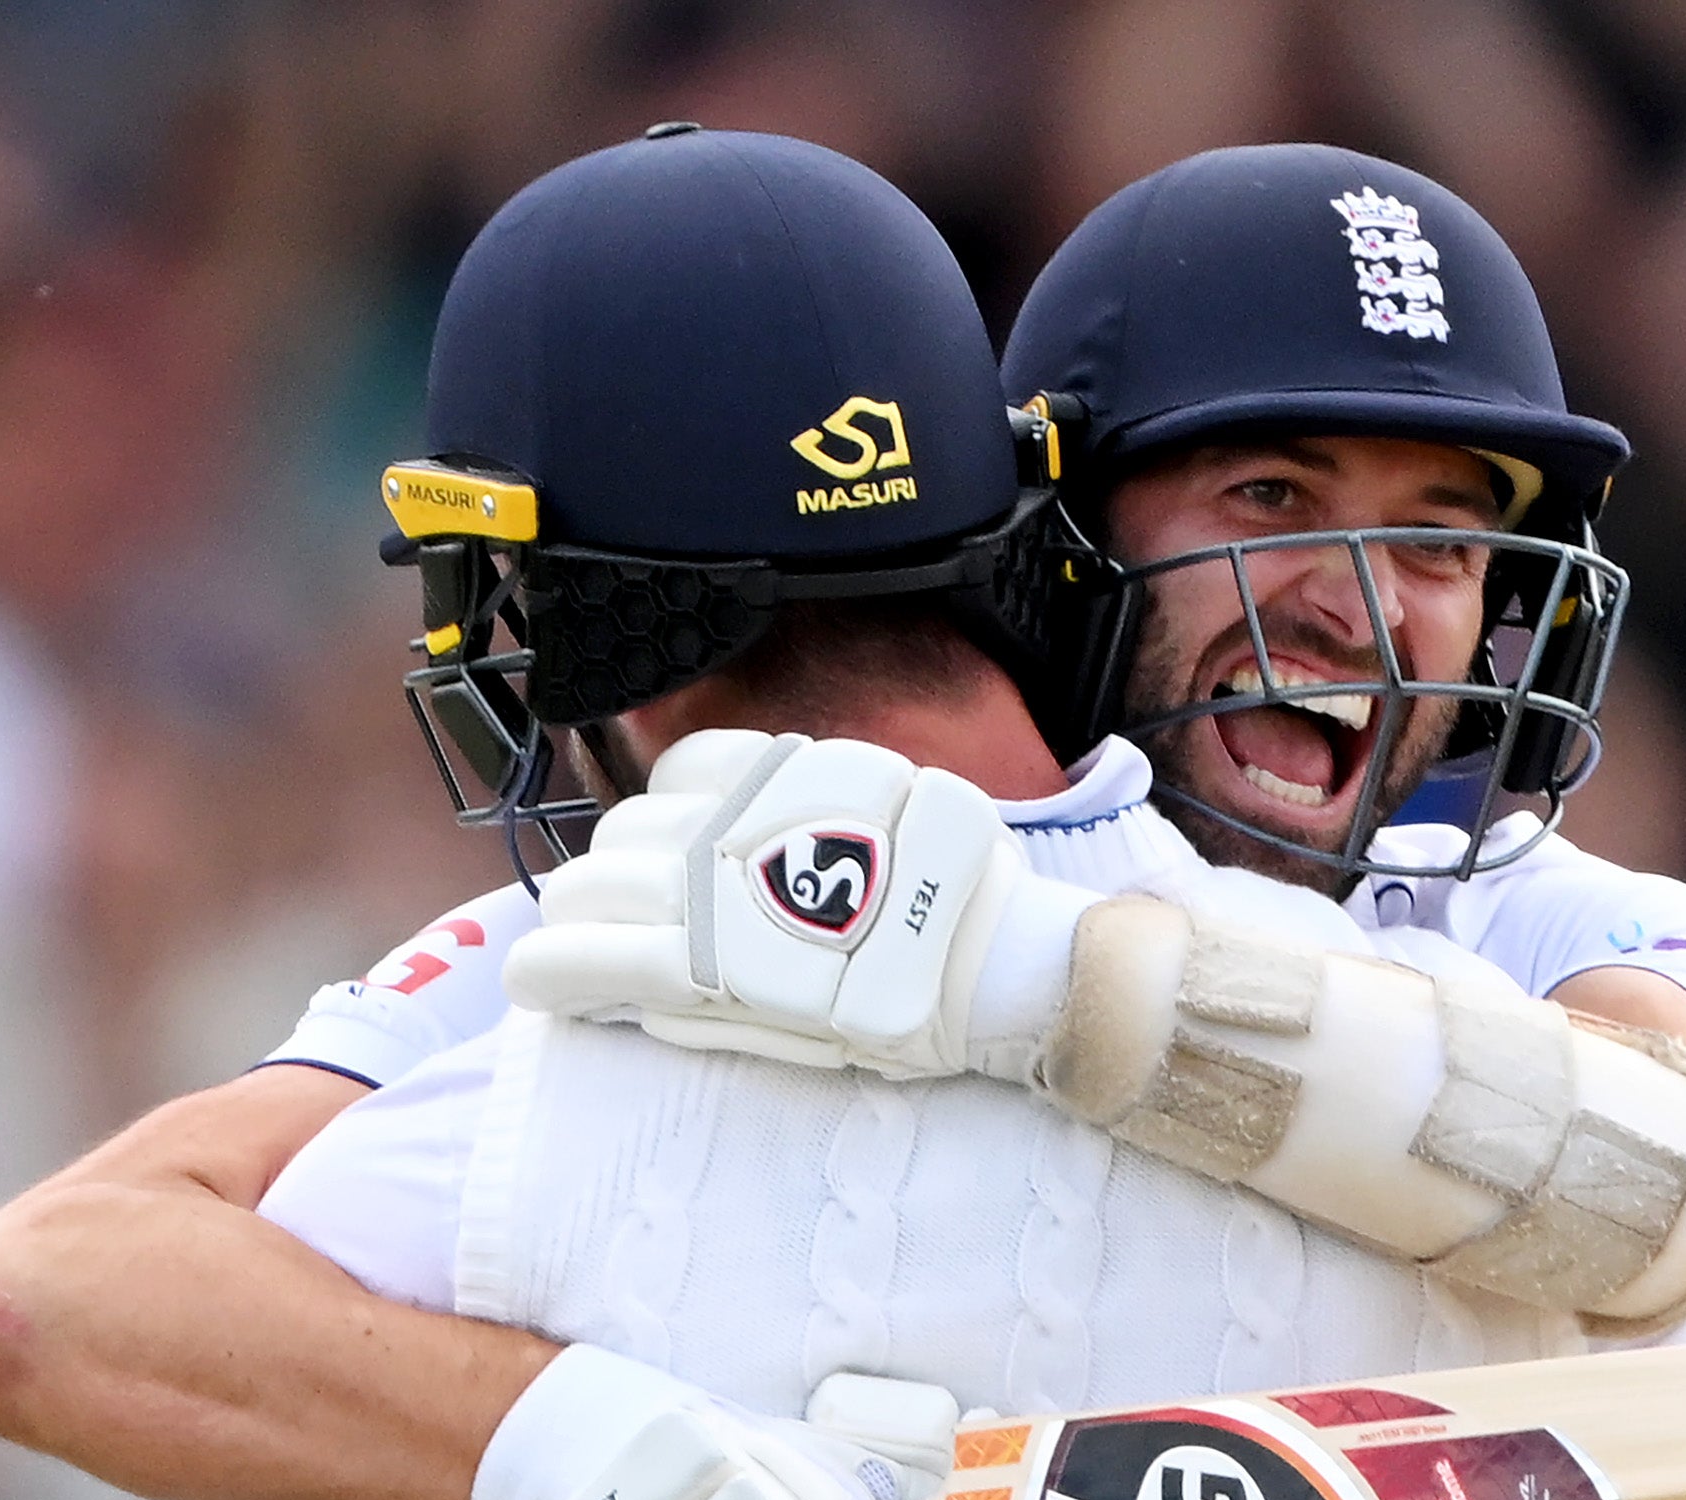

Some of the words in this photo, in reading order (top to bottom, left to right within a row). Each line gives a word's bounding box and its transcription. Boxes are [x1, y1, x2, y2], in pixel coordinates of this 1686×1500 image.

[407, 483, 476, 511] MASURI
[796, 476, 918, 515] MASURI
[905, 878, 941, 937] TEST
